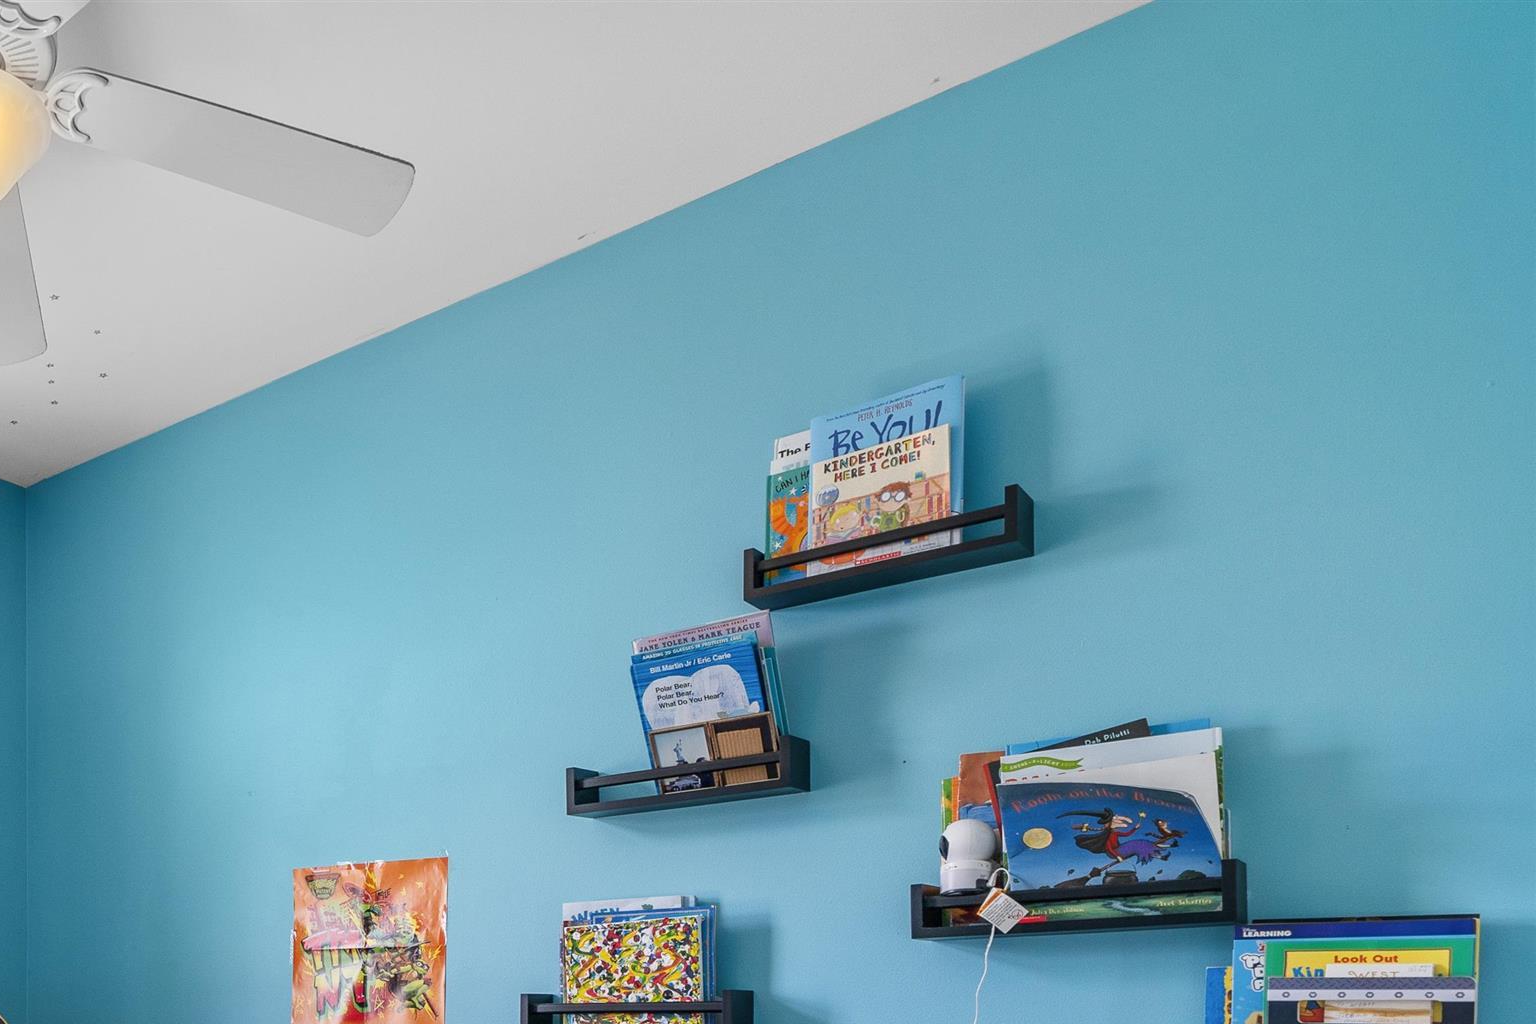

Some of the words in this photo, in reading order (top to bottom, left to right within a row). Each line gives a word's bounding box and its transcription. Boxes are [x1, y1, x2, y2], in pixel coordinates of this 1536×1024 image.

[857, 411, 874, 422] PETER
[884, 399, 913, 415] REYNOLDS
[778, 447, 802, 460] The
[823, 432, 937, 474] KINDERGARTEN,
[834, 464, 866, 483] HERE
[869, 463, 877, 474] I
[881, 450, 922, 470] COME!
[775, 479, 794, 492] CAN
[640, 643, 660, 653] JANE
[662, 638, 689, 648] YOLEN
[698, 631, 724, 641] MARK
[726, 622, 762, 634] TEAGUE
[649, 666, 661, 674] Bill
[662, 661, 684, 672] Martin
[697, 656, 711, 665] Eric
[713, 652, 732, 662] Carle
[655, 684, 673, 693] Polar
[674, 682, 693, 690] Bear,
[657, 693, 674, 701] Polar
[676, 690, 695, 699] Bear,
[658, 701, 677, 709] What
[704, 692, 725, 701] Hear?
[1011, 790, 1062, 814] Room
[1067, 787, 1090, 799] on
[1091, 787, 1128, 799] the
[1243, 930, 1292, 938] LEARNING
[1334, 955, 1367, 963] Look
[1373, 955, 1398, 963] Out
